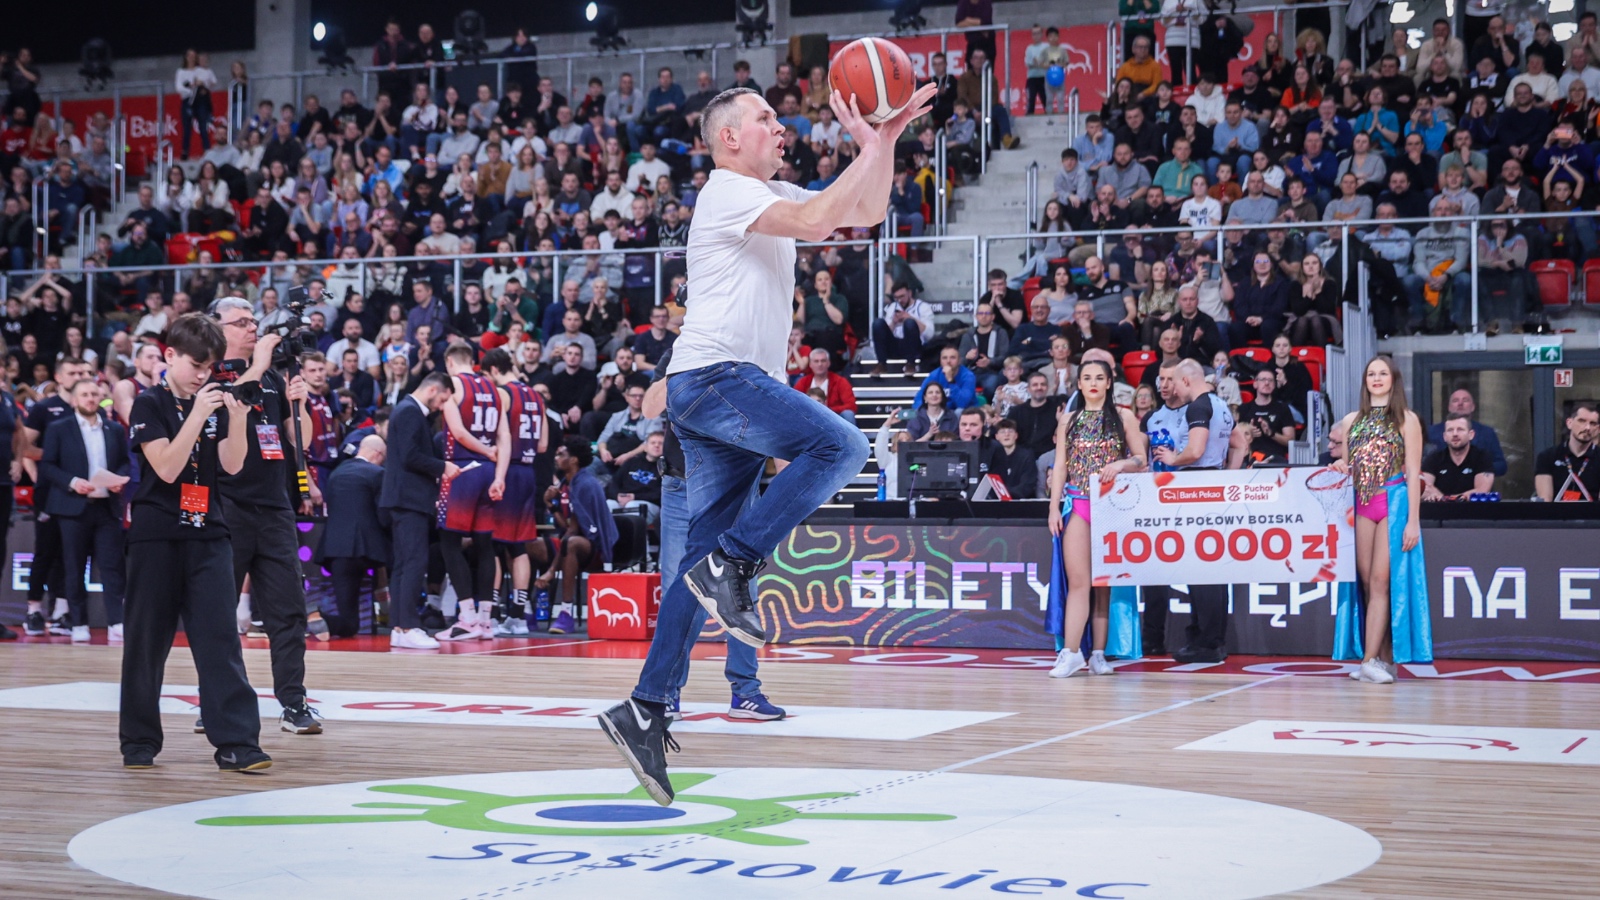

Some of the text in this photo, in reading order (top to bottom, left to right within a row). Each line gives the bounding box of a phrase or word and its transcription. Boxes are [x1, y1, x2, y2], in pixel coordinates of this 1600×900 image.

[951, 302, 965, 313] B5
[470, 405, 498, 432] 10
[519, 414, 542, 440] 21
[1179, 490, 1221, 499] Bank Pekao
[1244, 493, 1269, 501] Polski
[1134, 514, 1304, 527] RZUT Z POŁOWY BOISKA
[1103, 524, 1339, 564] 100 000 zł
[851, 560, 1050, 611] BILETY
[1443, 566, 1526, 618] NA
[341, 701, 798, 724] ORLN
[426, 842, 1151, 900] Sosnowiec
